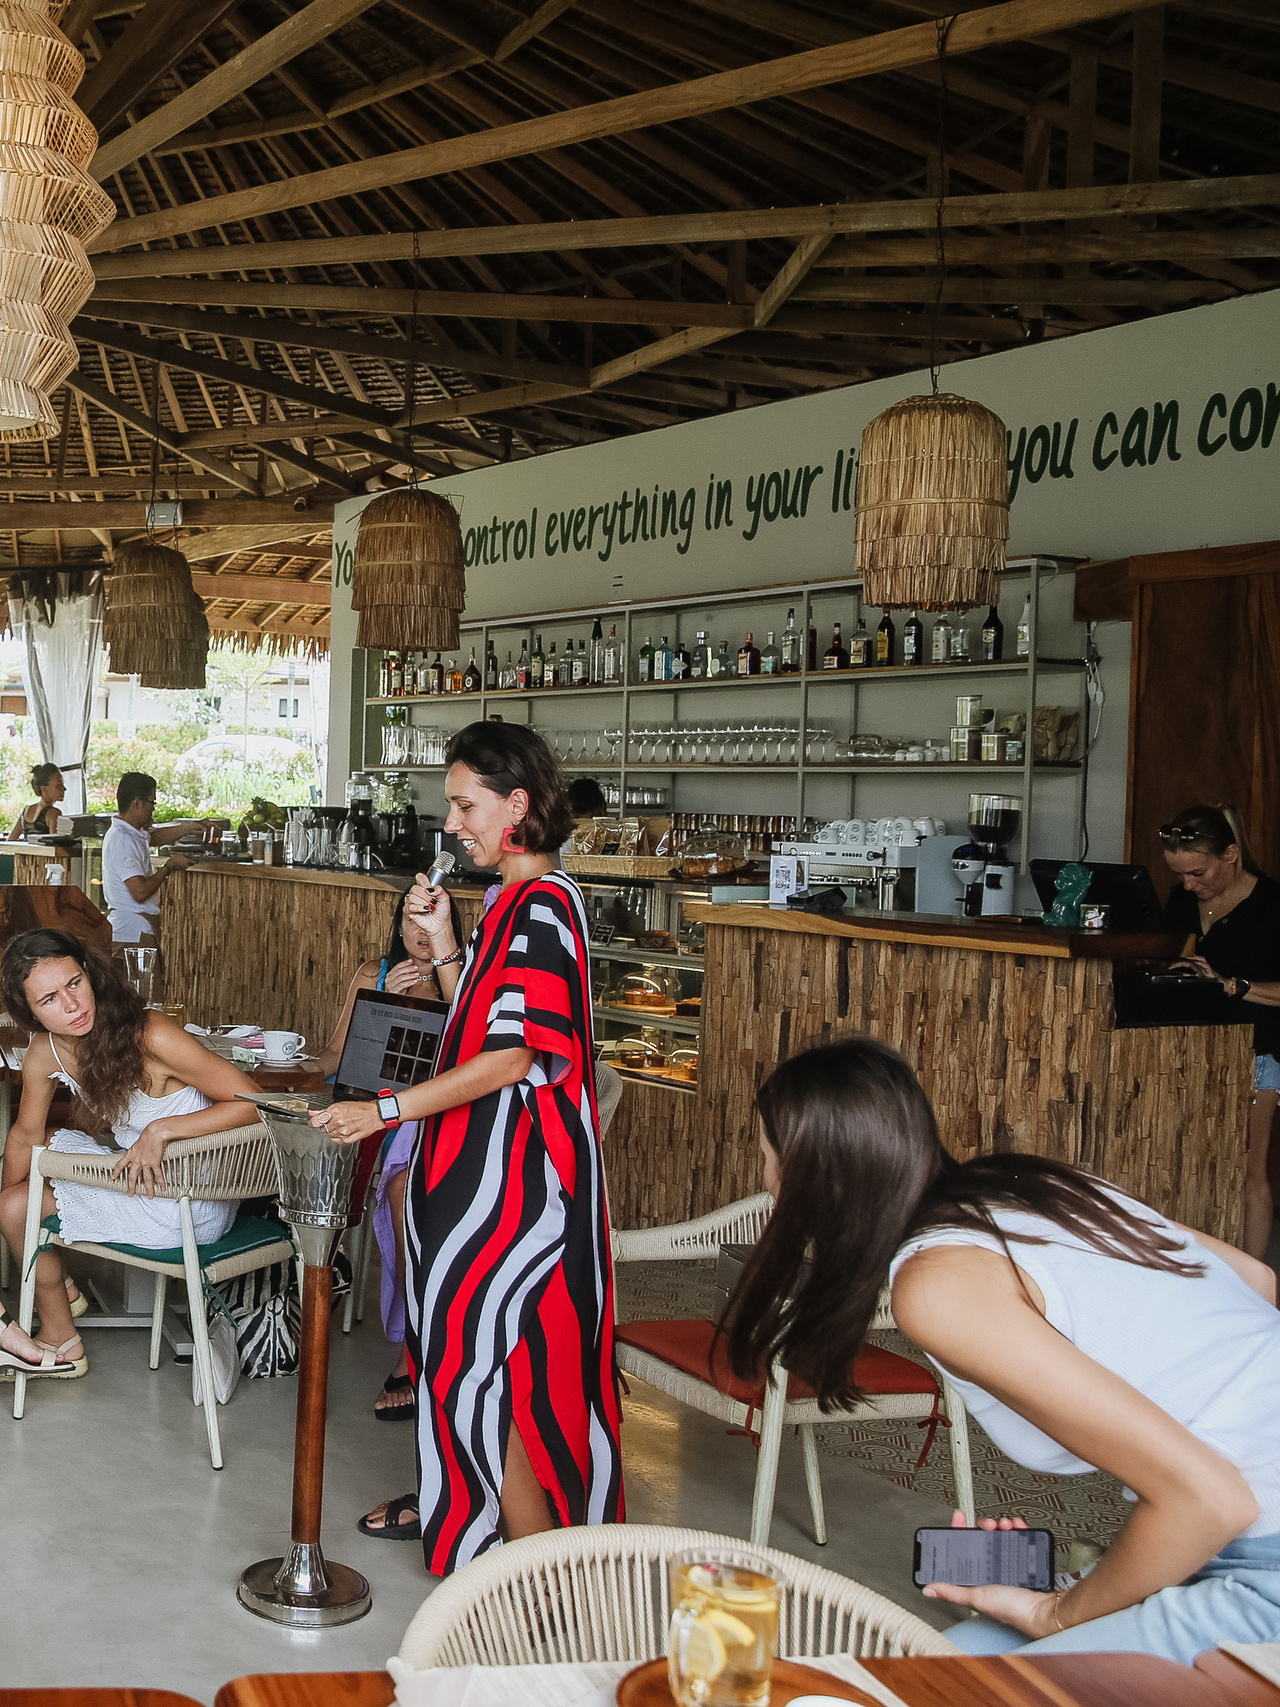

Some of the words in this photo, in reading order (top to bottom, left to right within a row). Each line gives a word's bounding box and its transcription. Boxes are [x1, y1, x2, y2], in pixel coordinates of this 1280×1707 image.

[335, 540, 354, 588] Yo
[464, 507, 538, 568] ontrol
[545, 484, 696, 562] everything
[704, 473, 734, 531] in
[742, 465, 824, 541] your
[831, 447, 860, 514] li
[1006, 417, 1079, 507] you
[1092, 399, 1182, 472] can
